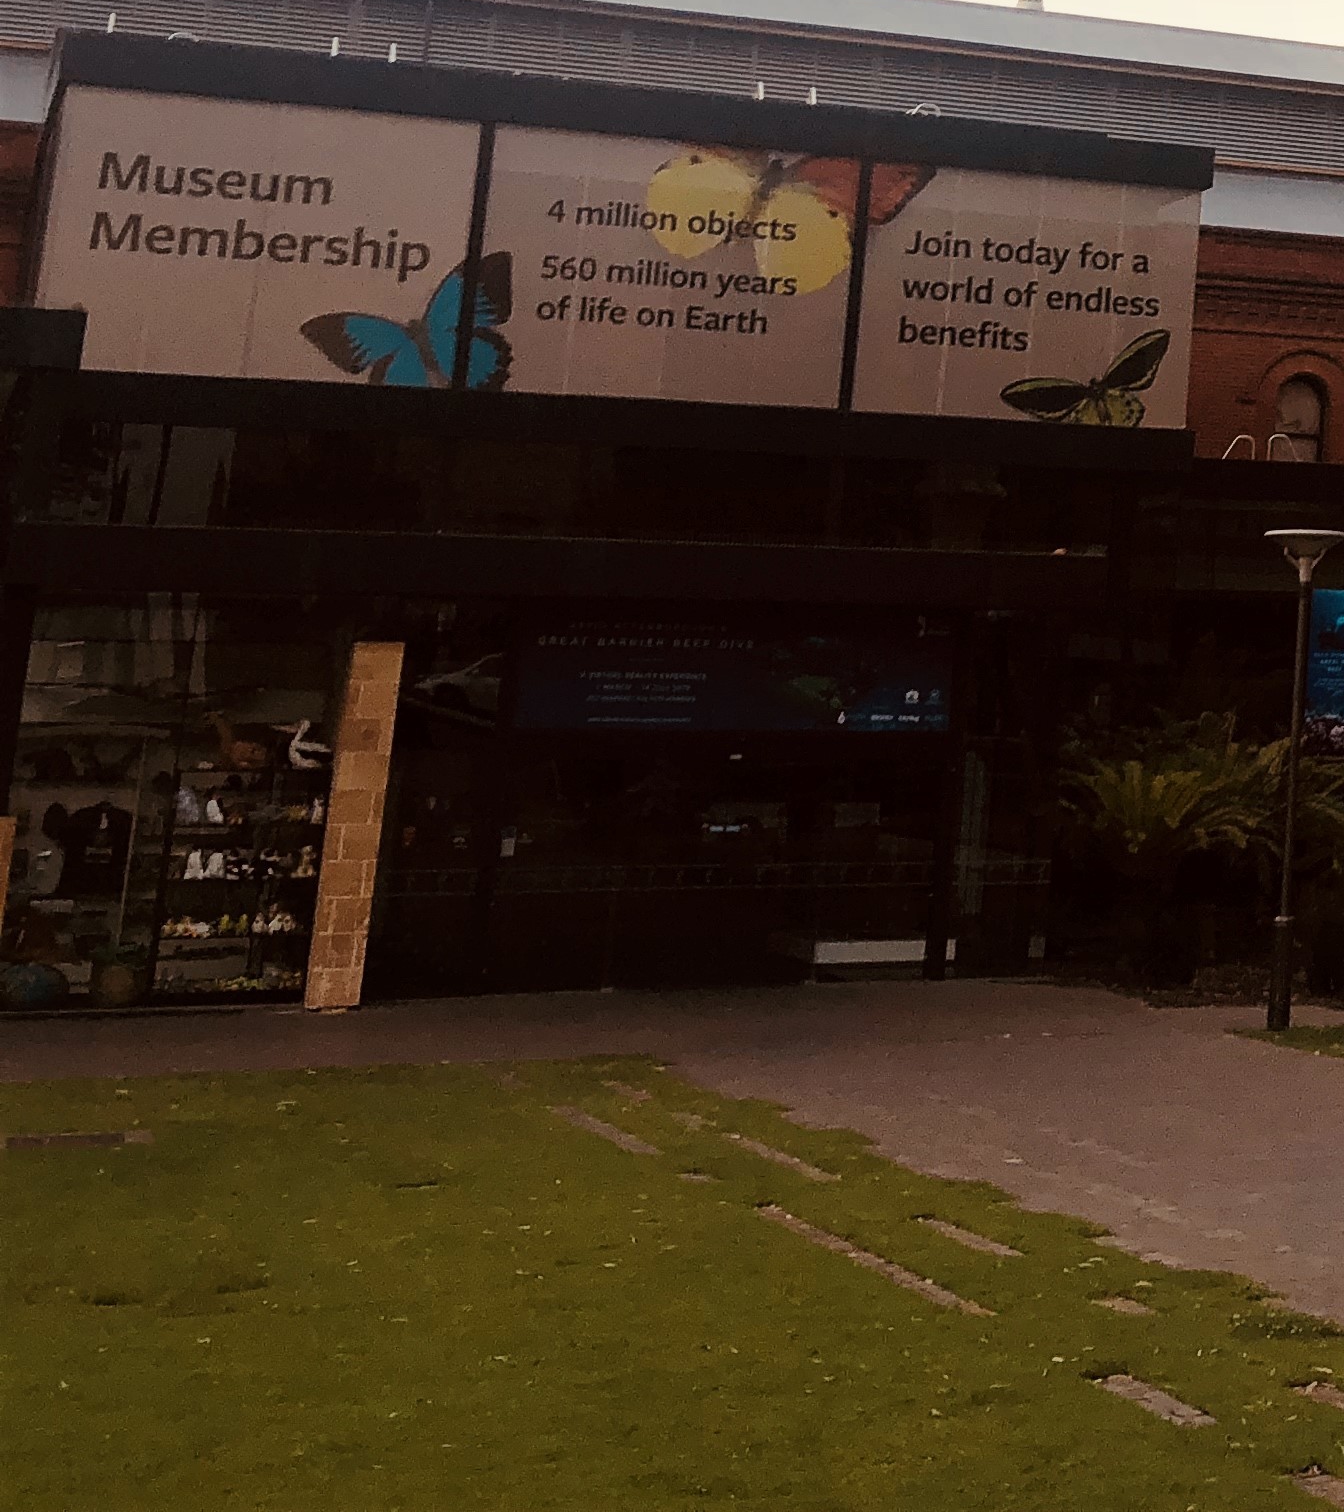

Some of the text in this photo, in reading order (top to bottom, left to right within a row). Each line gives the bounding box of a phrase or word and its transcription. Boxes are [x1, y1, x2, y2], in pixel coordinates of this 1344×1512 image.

[97, 151, 334, 205] Museum
[547, 199, 798, 243] 4 million objects
[88, 211, 432, 284] Membership
[904, 230, 1150, 275] Join today for a
[540, 254, 799, 299] 560 million years
[902, 275, 1161, 317] world of endless
[536, 294, 769, 335] of life on Earth
[897, 315, 1030, 352] benefits
